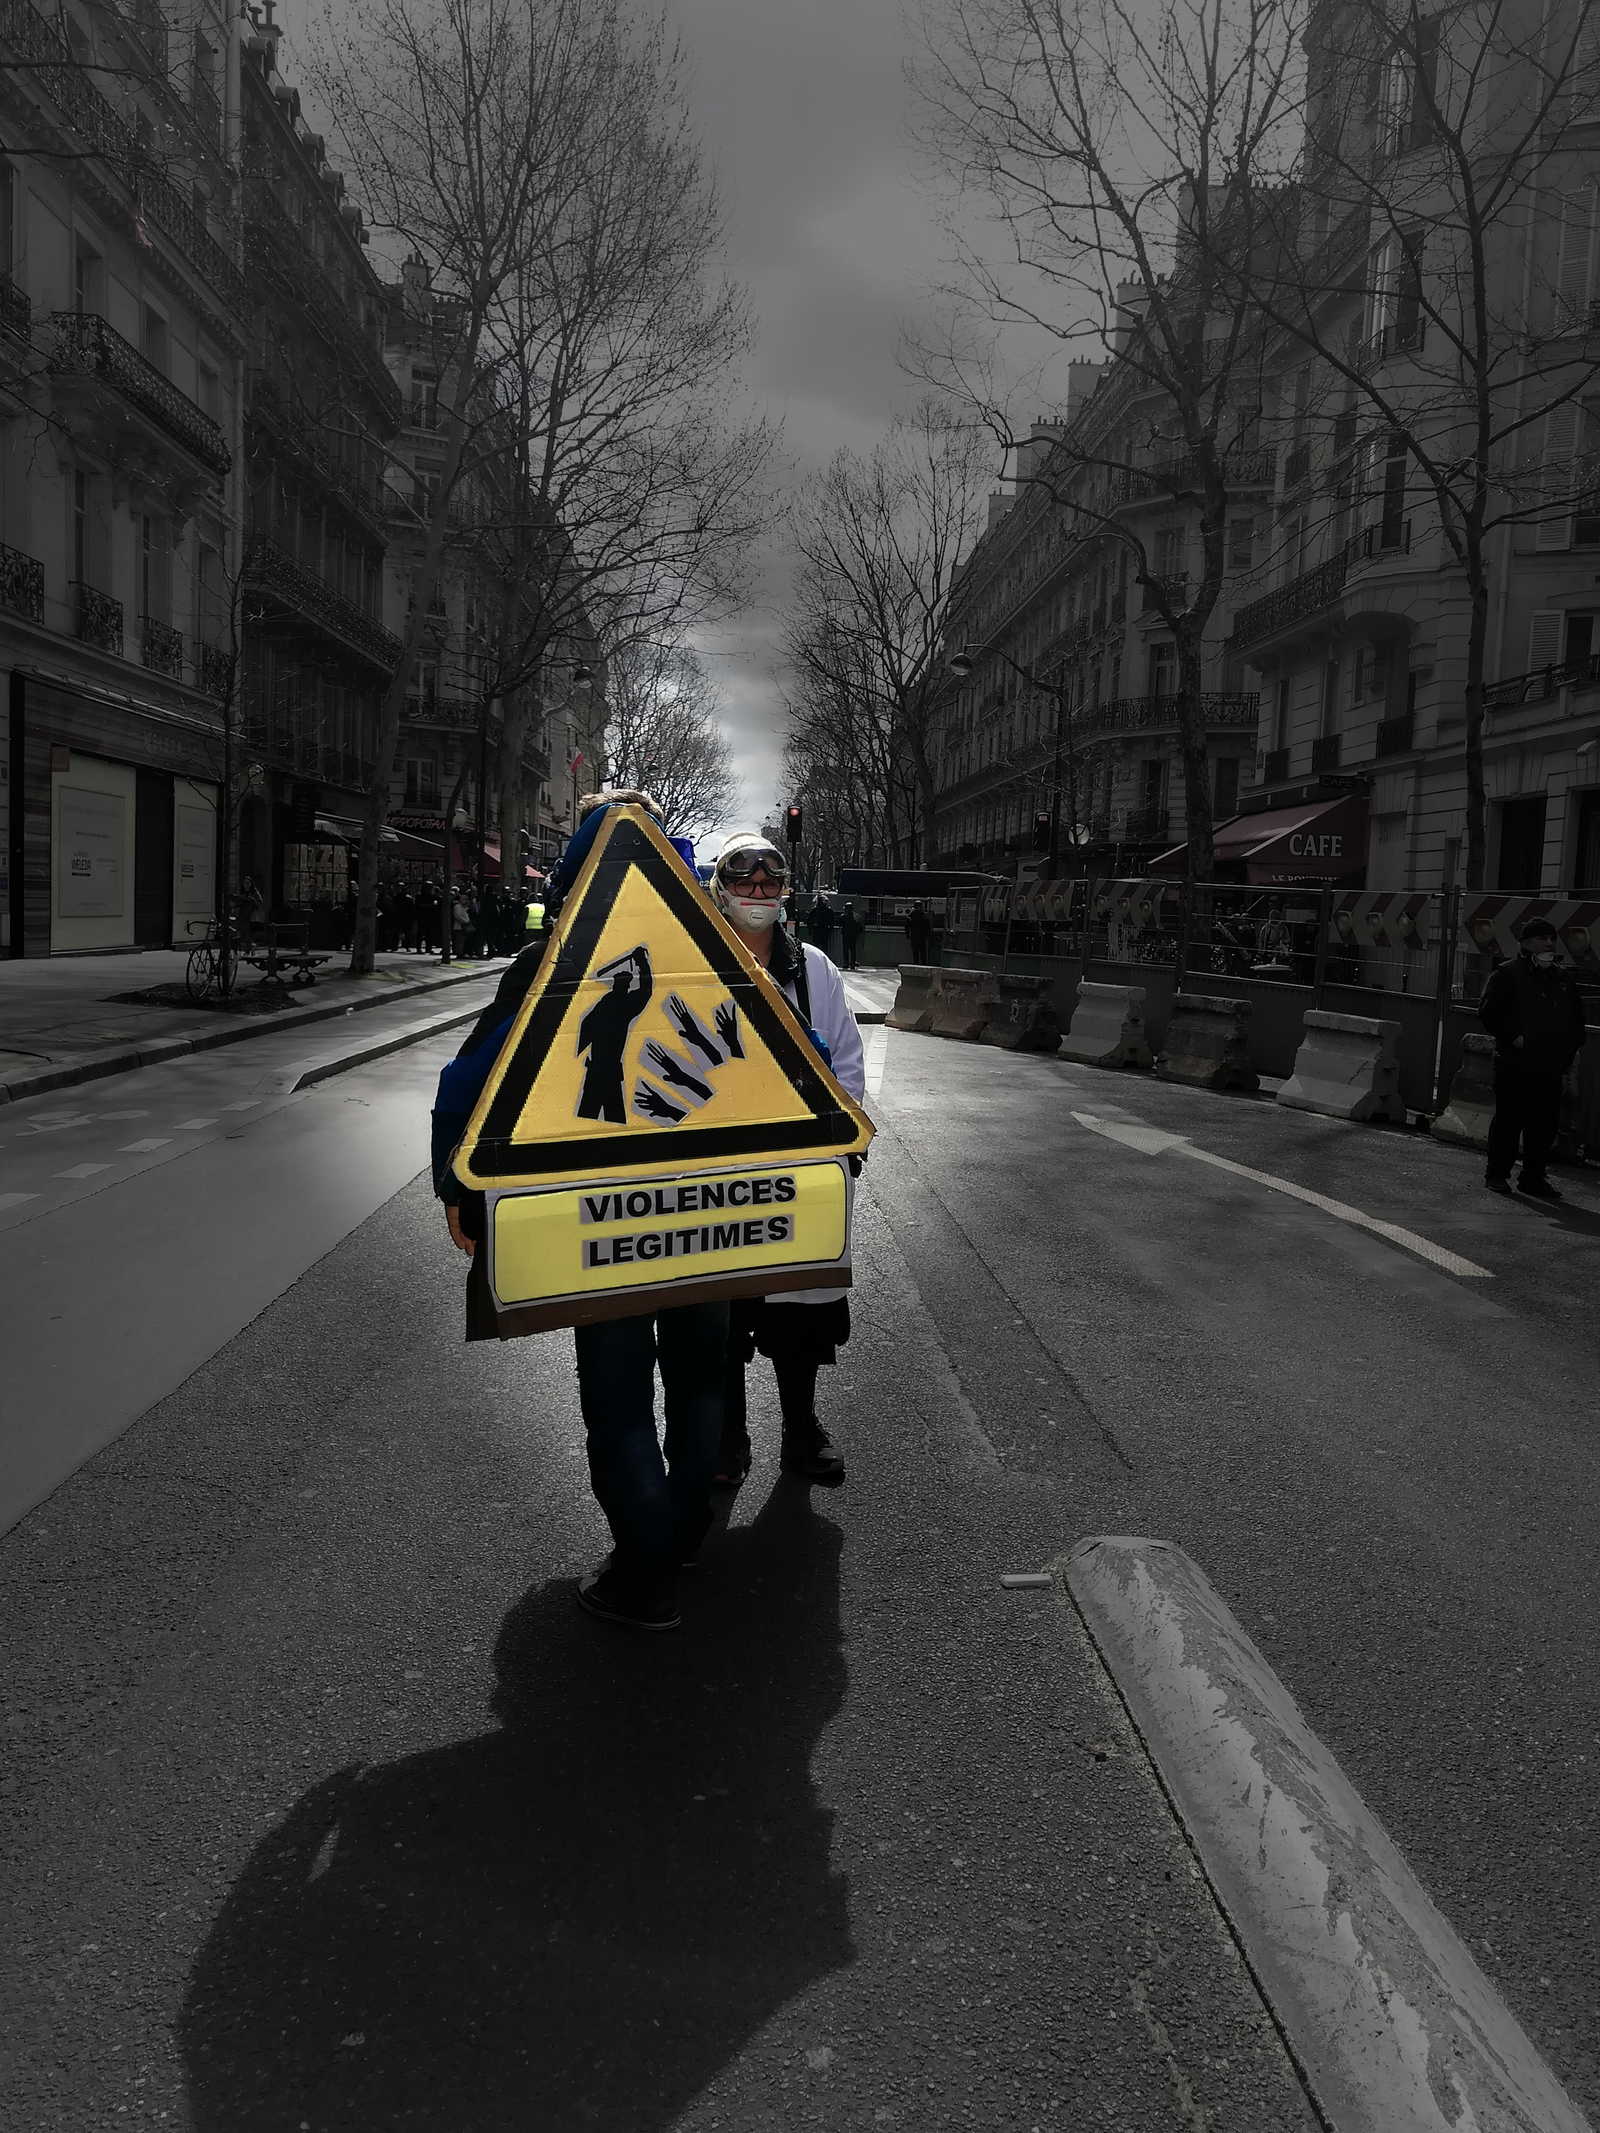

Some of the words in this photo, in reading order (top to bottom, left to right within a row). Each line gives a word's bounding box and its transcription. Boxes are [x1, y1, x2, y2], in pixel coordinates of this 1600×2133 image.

[1289, 834, 1343, 857] CAFE
[585, 1176, 796, 1222] VIOLENCES
[590, 1216, 788, 1267] LEGITIMES
